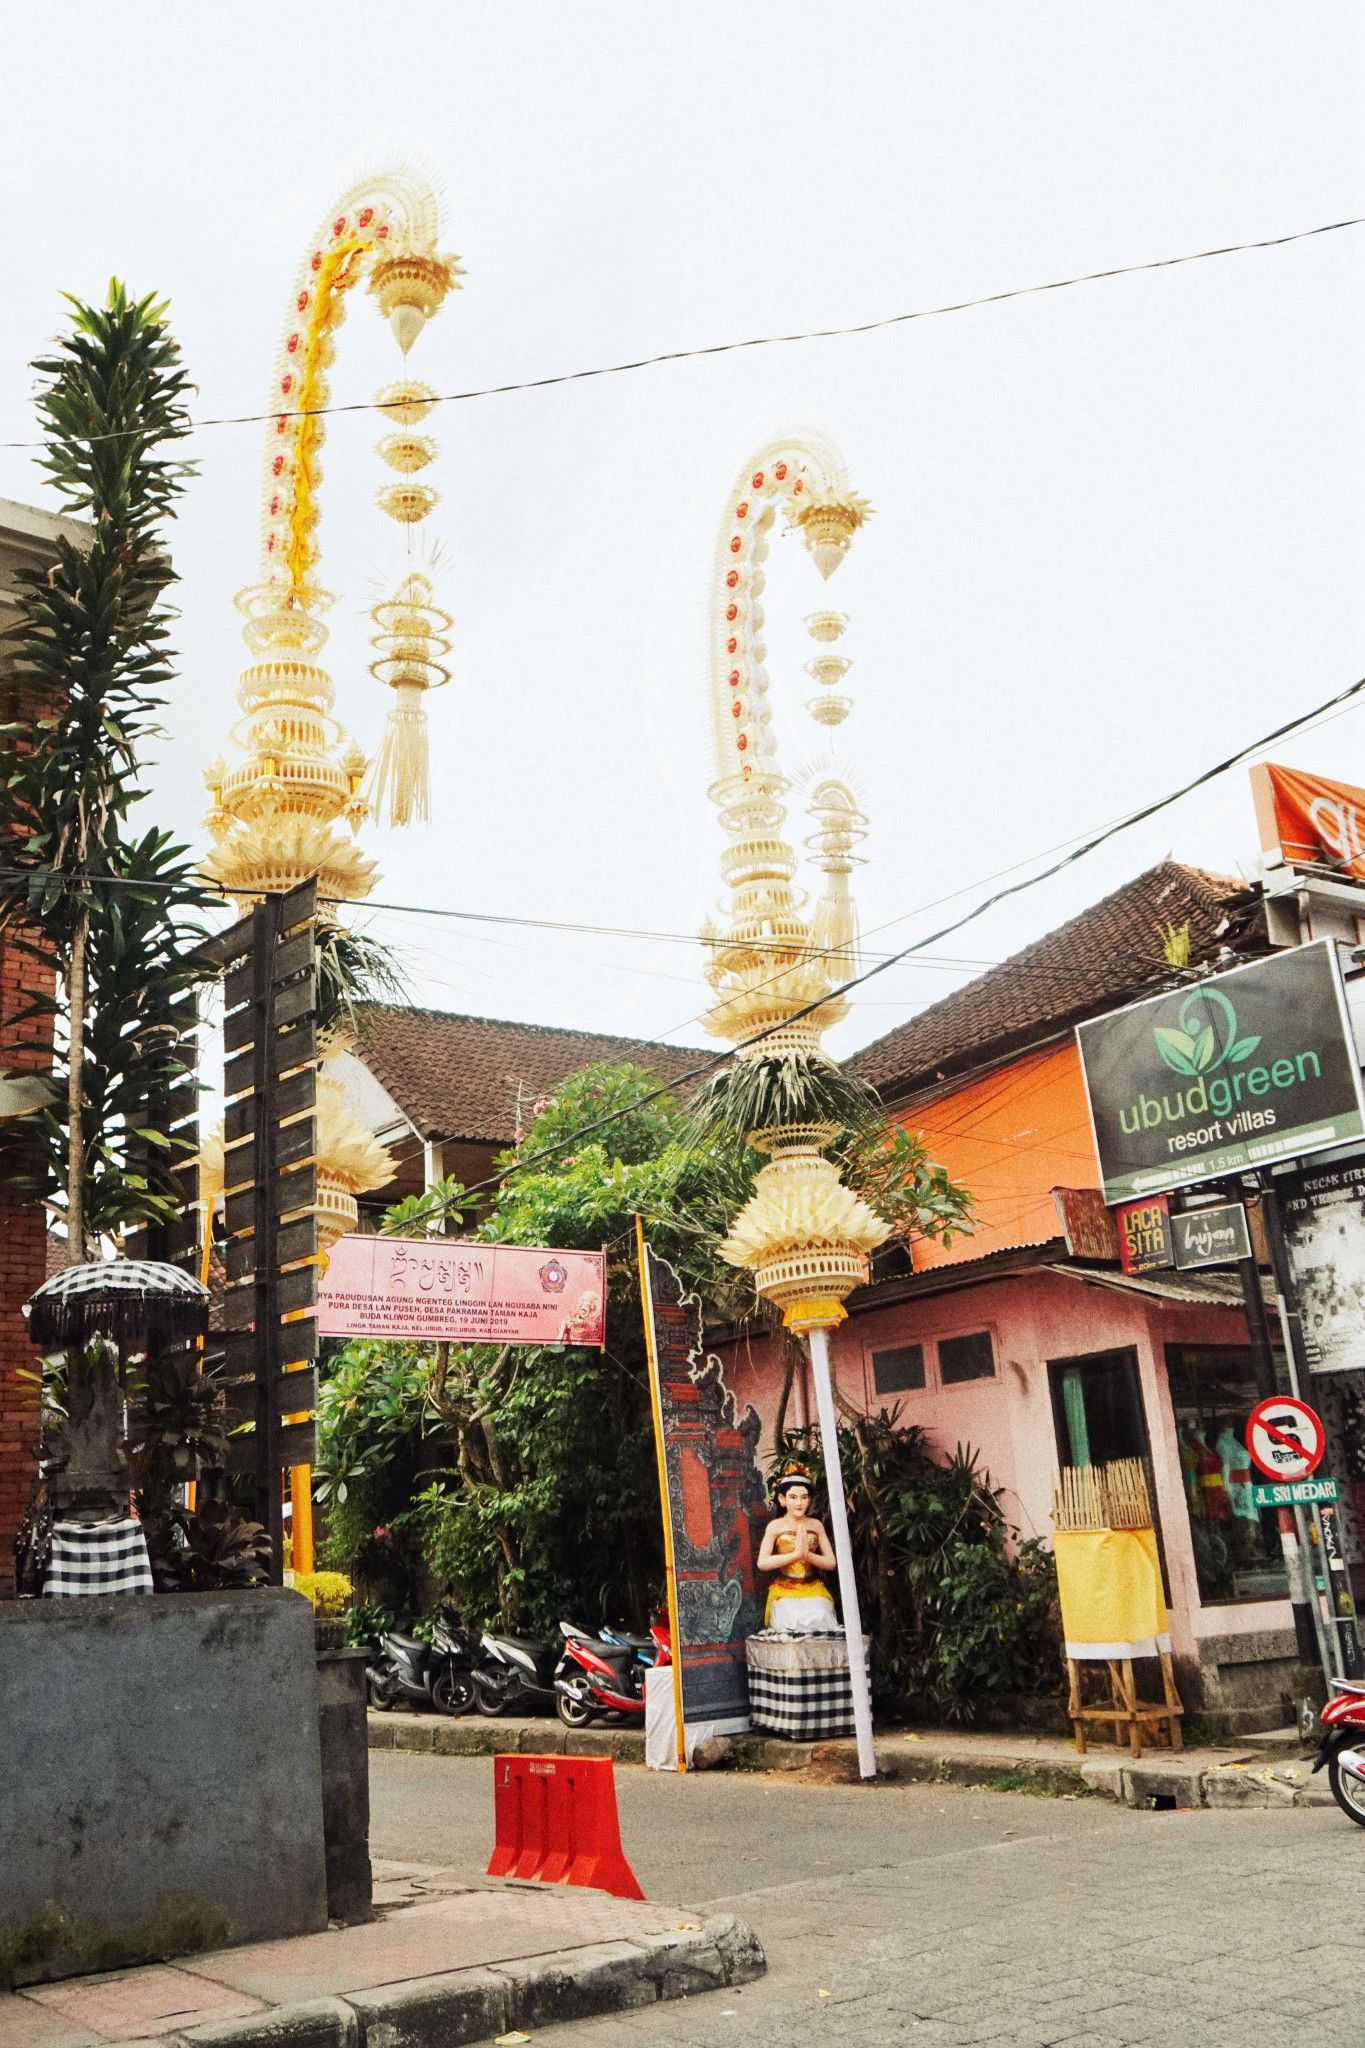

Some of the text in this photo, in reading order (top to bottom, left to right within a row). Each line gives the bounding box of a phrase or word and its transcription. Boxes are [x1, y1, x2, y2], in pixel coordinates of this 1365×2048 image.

[1119, 1051, 1321, 1134] ubudgreen
[1167, 1108, 1277, 1153] resort villas
[1209, 1153, 1244, 1171] 1.5 km
[1123, 1205, 1163, 1234] LACA
[1126, 1227, 1165, 1257] SITA
[1184, 1220, 1235, 1256] hujan
[328, 1301, 350, 1310] PURA
[352, 1303, 373, 1311] DESA
[375, 1304, 391, 1312] LAN
[393, 1305, 422, 1314] PUSEH,
[424, 1306, 444, 1314] DESA
[446, 1307, 489, 1316] PAKRAMAN
[490, 1309, 516, 1317] TAMAN
[335, 1293, 384, 1302] PADUDUSAN
[386, 1296, 414, 1304] AGUNG
[416, 1297, 453, 1307] NGENTEG
[455, 1299, 486, 1308] LINGGIH
[488, 1301, 503, 1309] LAN
[505, 1302, 540, 1310] NGUSABA
[542, 1303, 558, 1311] NINI
[360, 1312, 381, 1320] BUDA
[383, 1313, 415, 1321] KLIWON
[416, 1315, 457, 1324] GUMBREG,
[470, 1317, 488, 1325] JUNI
[1256, 1481, 1337, 1504] JL. SRI WEDARI
